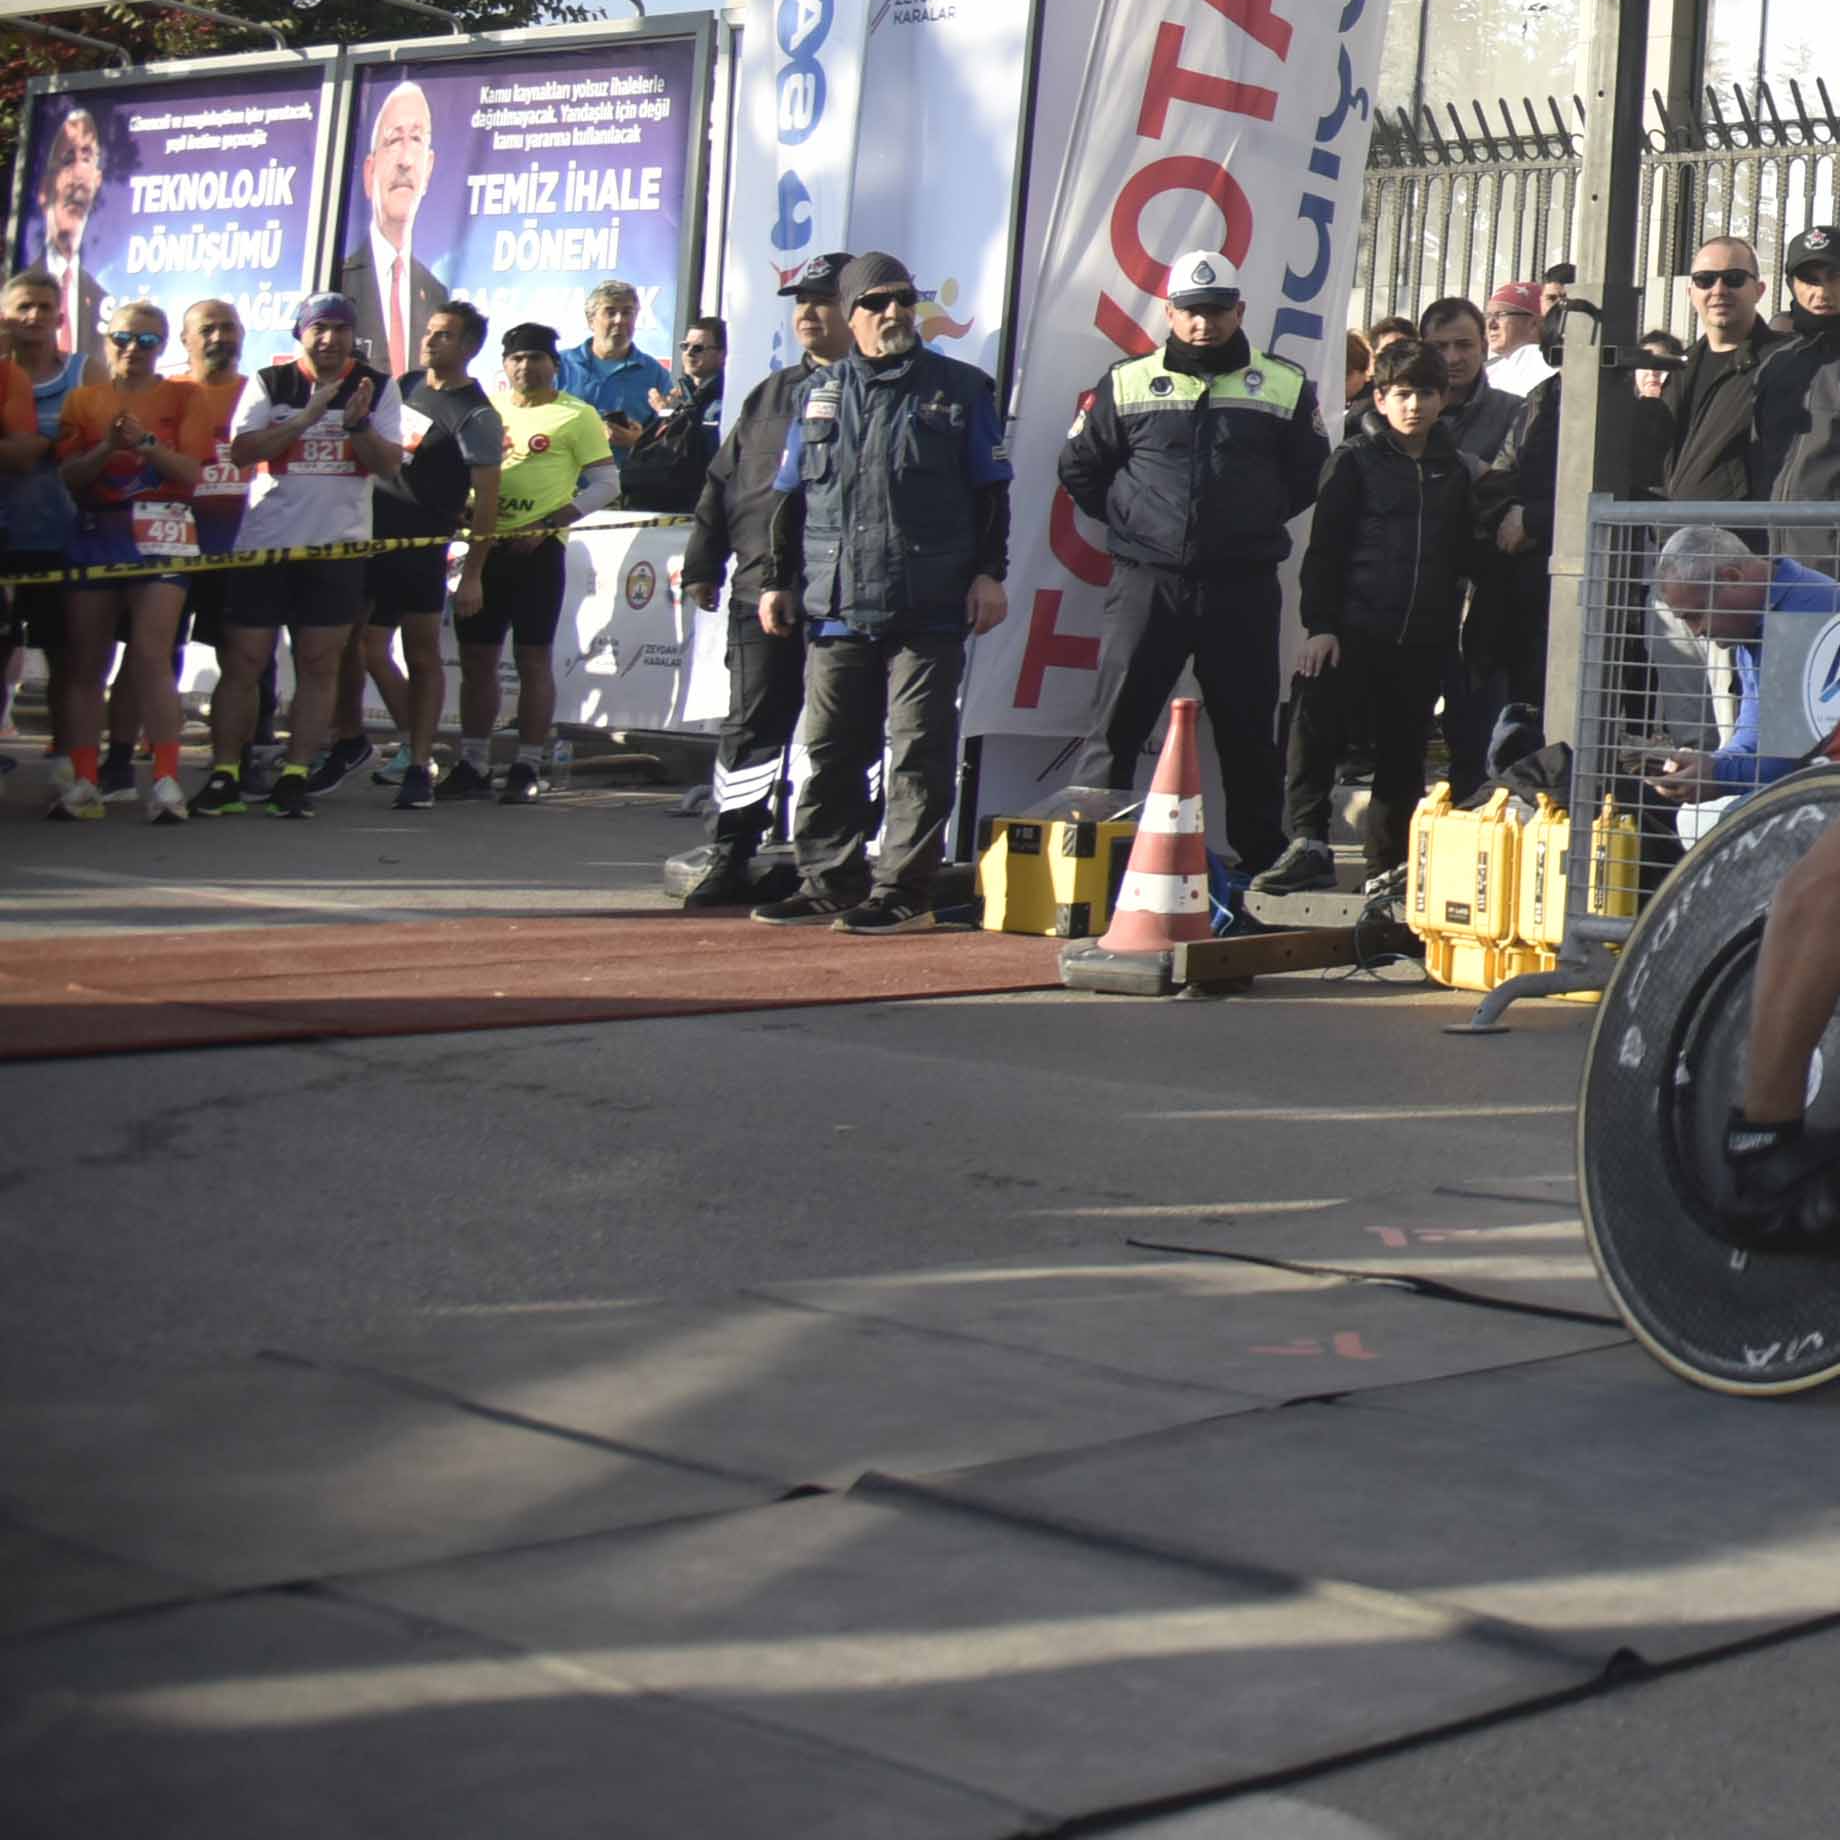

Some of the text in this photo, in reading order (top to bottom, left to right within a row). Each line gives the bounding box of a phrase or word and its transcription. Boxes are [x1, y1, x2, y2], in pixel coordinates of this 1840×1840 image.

[894, 6, 957, 24] KARALAR
[129, 158, 297, 214] TEKNOLOJİK
[468, 160, 663, 215] TEMİZ İHALE
[127, 219, 283, 275] DÖNÜŞÜMÜ
[492, 217, 620, 272] DÖNEMİ
[303, 440, 344, 461] 821
[203, 466, 240, 483] 671
[148, 521, 188, 543] 491
